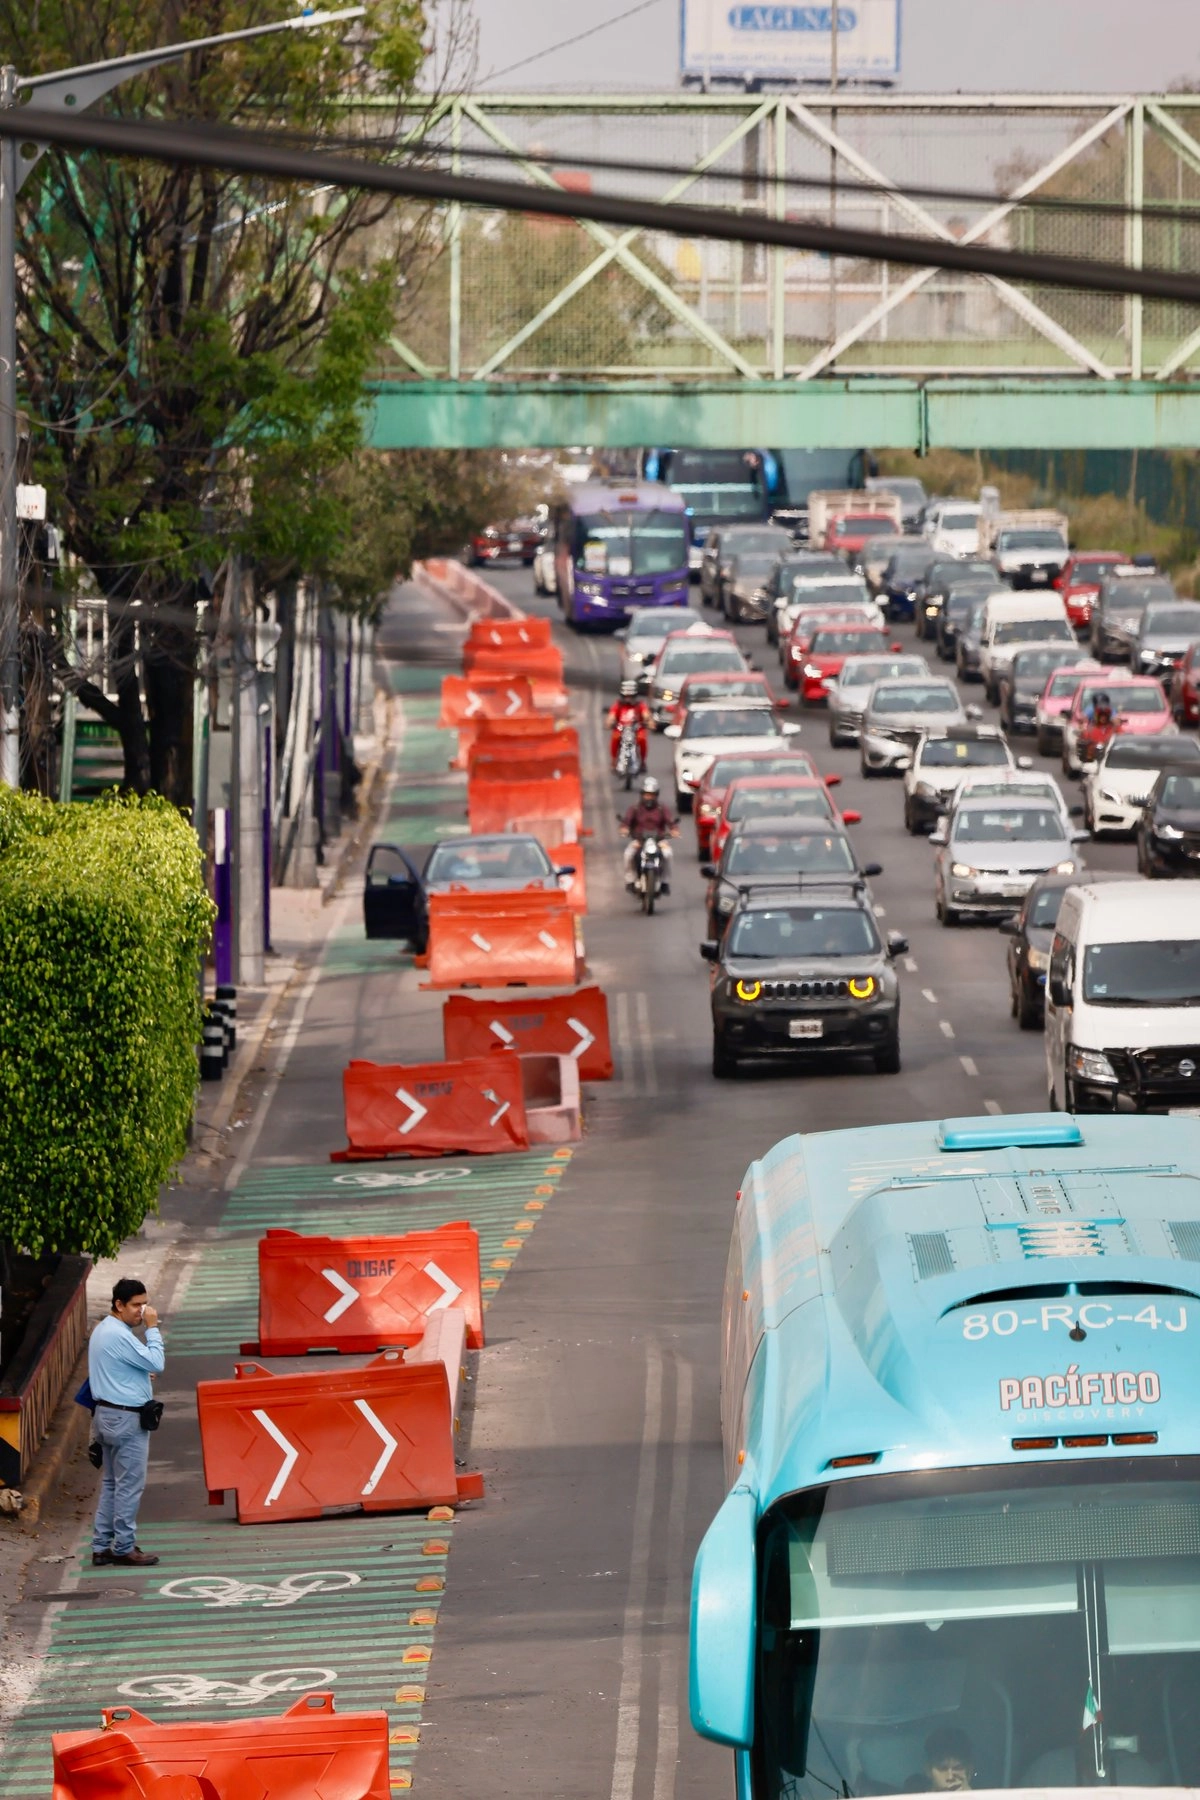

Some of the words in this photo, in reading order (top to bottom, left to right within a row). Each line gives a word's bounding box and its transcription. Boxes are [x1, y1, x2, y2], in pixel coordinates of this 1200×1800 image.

[962, 1304, 1187, 1340] 80-RC-4J
[999, 1364, 1161, 1410] PACÍFICO
[1016, 1406, 1146, 1423] DISCOVERY
